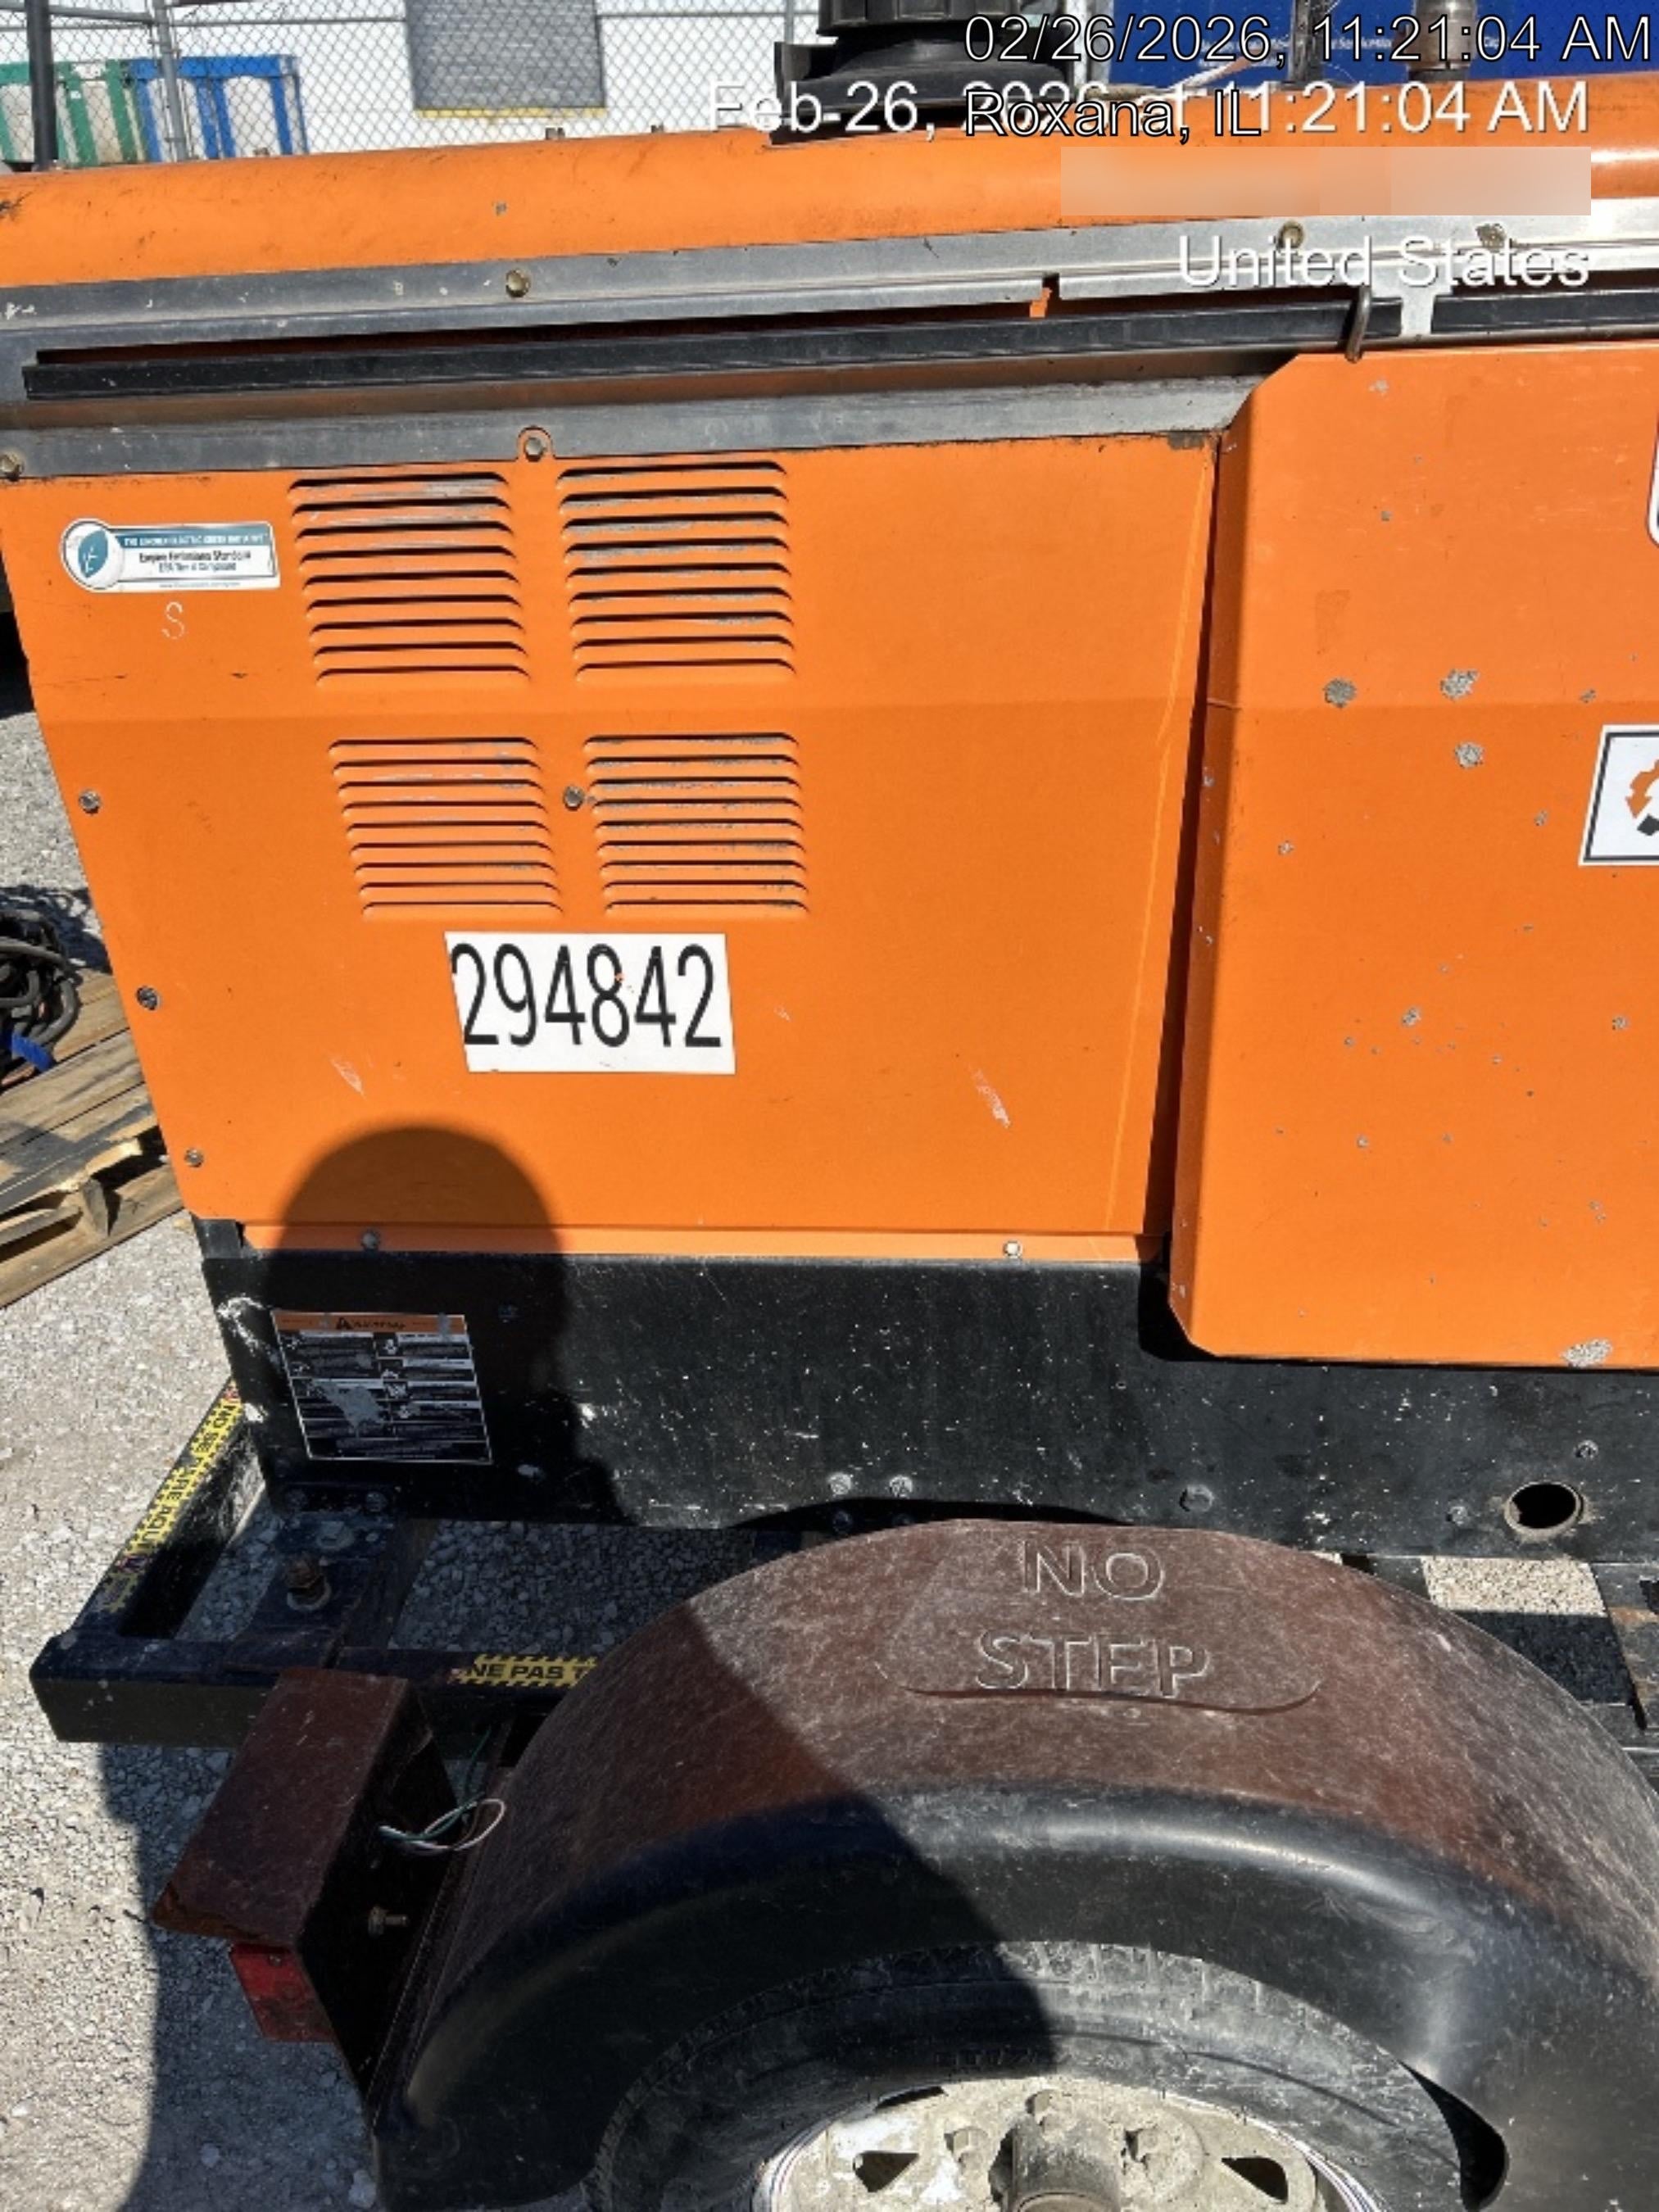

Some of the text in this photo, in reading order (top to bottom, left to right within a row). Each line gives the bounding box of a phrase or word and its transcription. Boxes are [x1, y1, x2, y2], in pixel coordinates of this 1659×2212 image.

[450, 942, 722, 1047] 294842
[1020, 1539, 1166, 1602] NO
[468, 1663, 506, 1678] NE
[510, 1665, 564, 1679] PAS
[975, 1632, 1211, 1698] STEP
